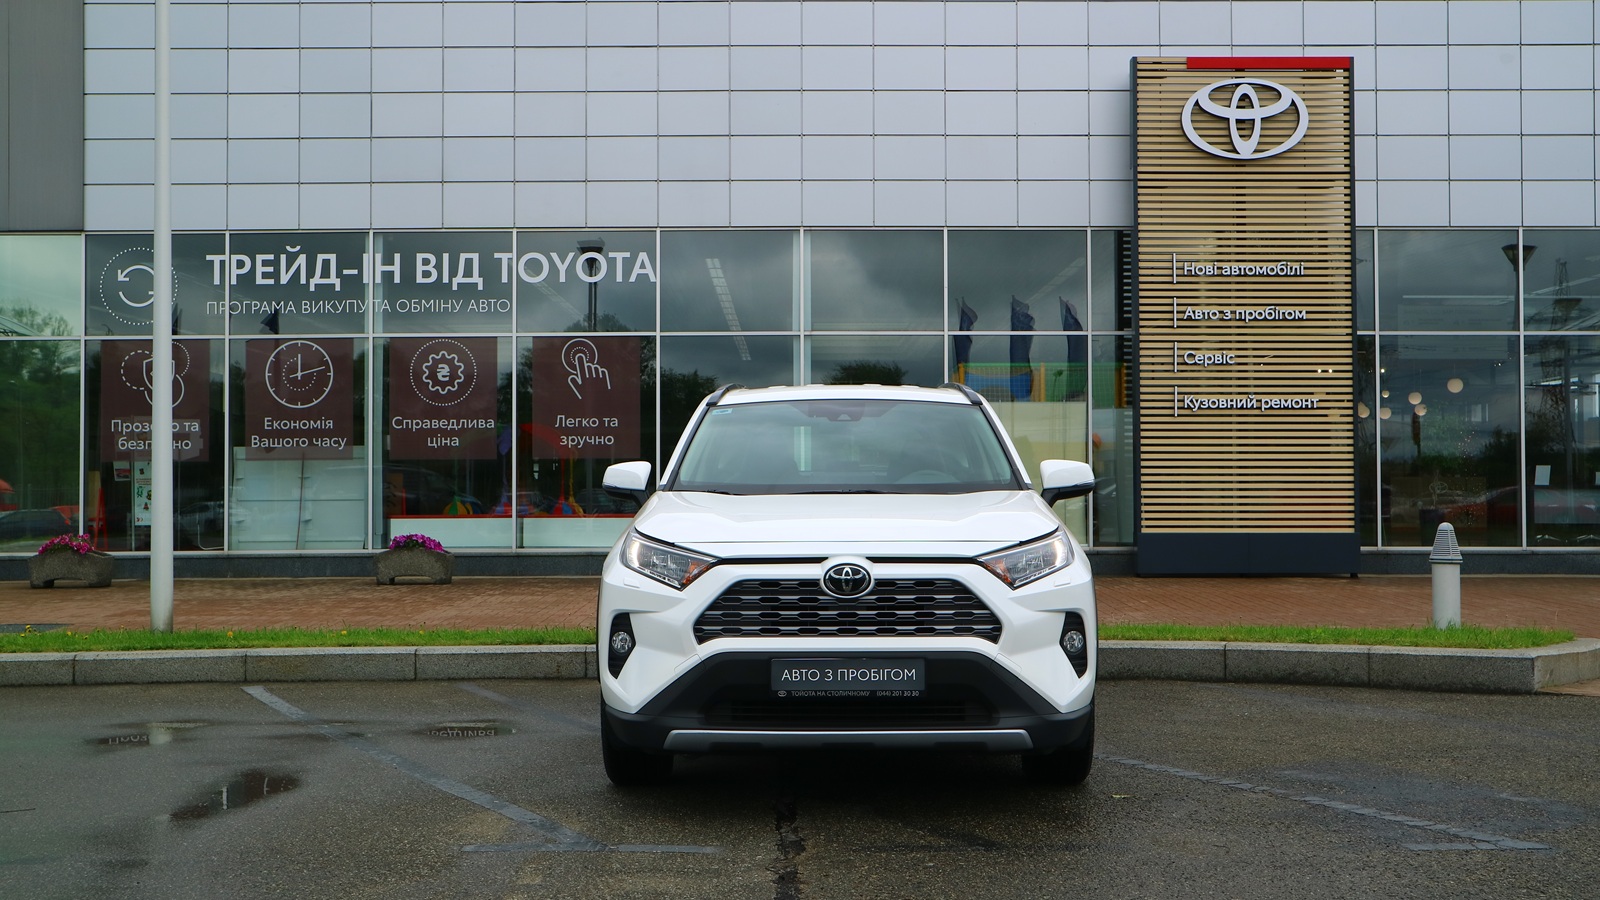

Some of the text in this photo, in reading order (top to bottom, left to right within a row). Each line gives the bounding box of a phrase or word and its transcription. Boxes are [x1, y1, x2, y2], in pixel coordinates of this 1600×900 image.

[206, 246, 657, 291] ТРЕЙД-ІН ВІД TOYOTA
[1183, 261, 1305, 276] Нові автомобілі
[206, 299, 511, 315] ПРОГРАМА ВИКУПУ ТА ОБМІНУ АВТО
[1183, 305, 1307, 323] Авто з пробігом
[1183, 351, 1235, 367] Сервіс
[1183, 394, 1319, 412] Кузовний ремонт
[111, 419, 199, 435] Прозо та
[264, 417, 334, 430] Економія
[392, 416, 495, 431] Справедлива
[555, 414, 619, 428] Легко та
[118, 436, 192, 450] безпно
[251, 435, 347, 450] Вашого часу
[427, 434, 460, 448] ціна
[559, 433, 615, 447] зручно
[781, 669, 820, 681] АВТО
[838, 668, 916, 681] ПРОБІГОМ
